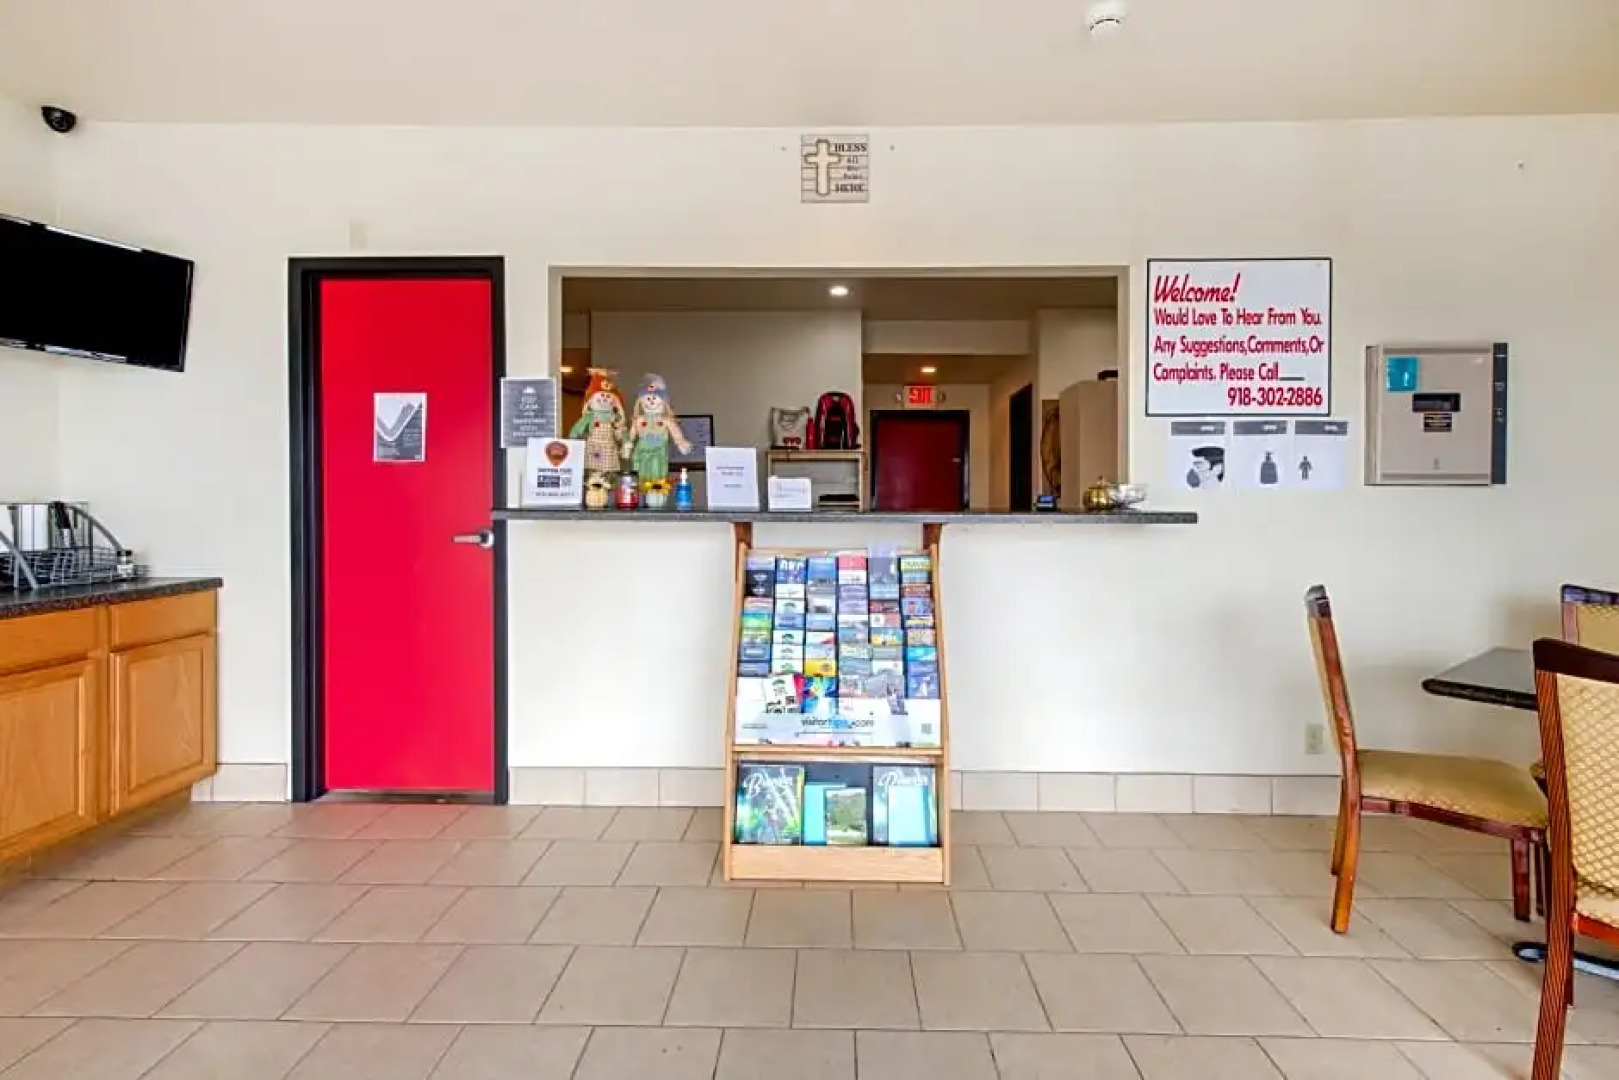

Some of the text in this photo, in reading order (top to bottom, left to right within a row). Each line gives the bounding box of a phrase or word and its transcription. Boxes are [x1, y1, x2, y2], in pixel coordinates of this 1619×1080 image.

[1154, 273, 1241, 303] Welcome!
[1154, 308, 1189, 325] Would
[1192, 308, 1217, 325] Love
[1221, 308, 1235, 325] To
[1236, 308, 1264, 325] Hear
[1267, 308, 1296, 325] From
[1154, 335, 1177, 358] Any
[1153, 362, 1217, 384] Complaints.
[1219, 362, 1255, 381] Please
[1227, 387, 1323, 406] 918-302-2886
